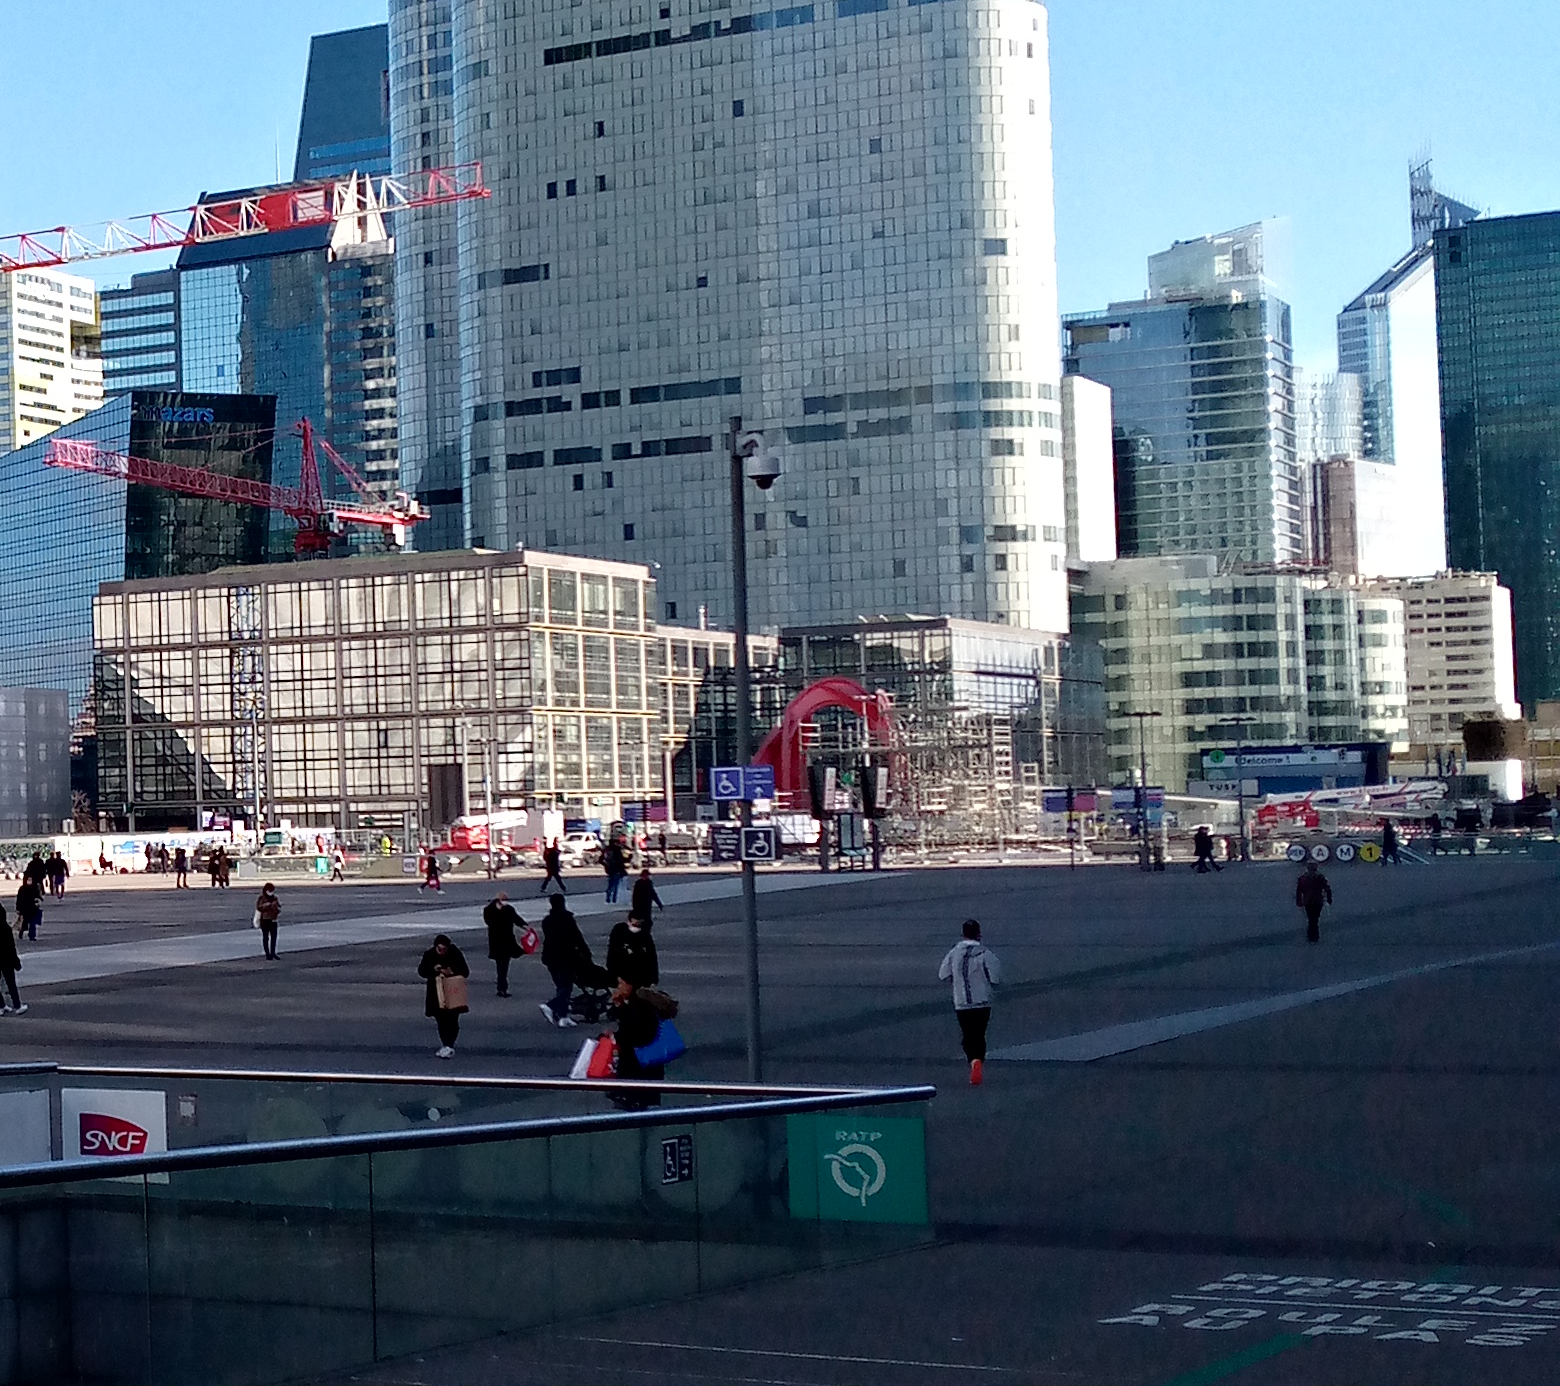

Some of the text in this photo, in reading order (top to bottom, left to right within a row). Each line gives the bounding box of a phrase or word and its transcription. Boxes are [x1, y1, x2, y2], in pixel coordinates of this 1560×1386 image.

[140, 405, 215, 423] mazars
[83, 1130, 144, 1152] SNCF
[835, 1130, 883, 1142] RATP
[1131, 1302, 1559, 1335] ROULEZ
[1097, 1315, 1531, 1346] AU PAS
